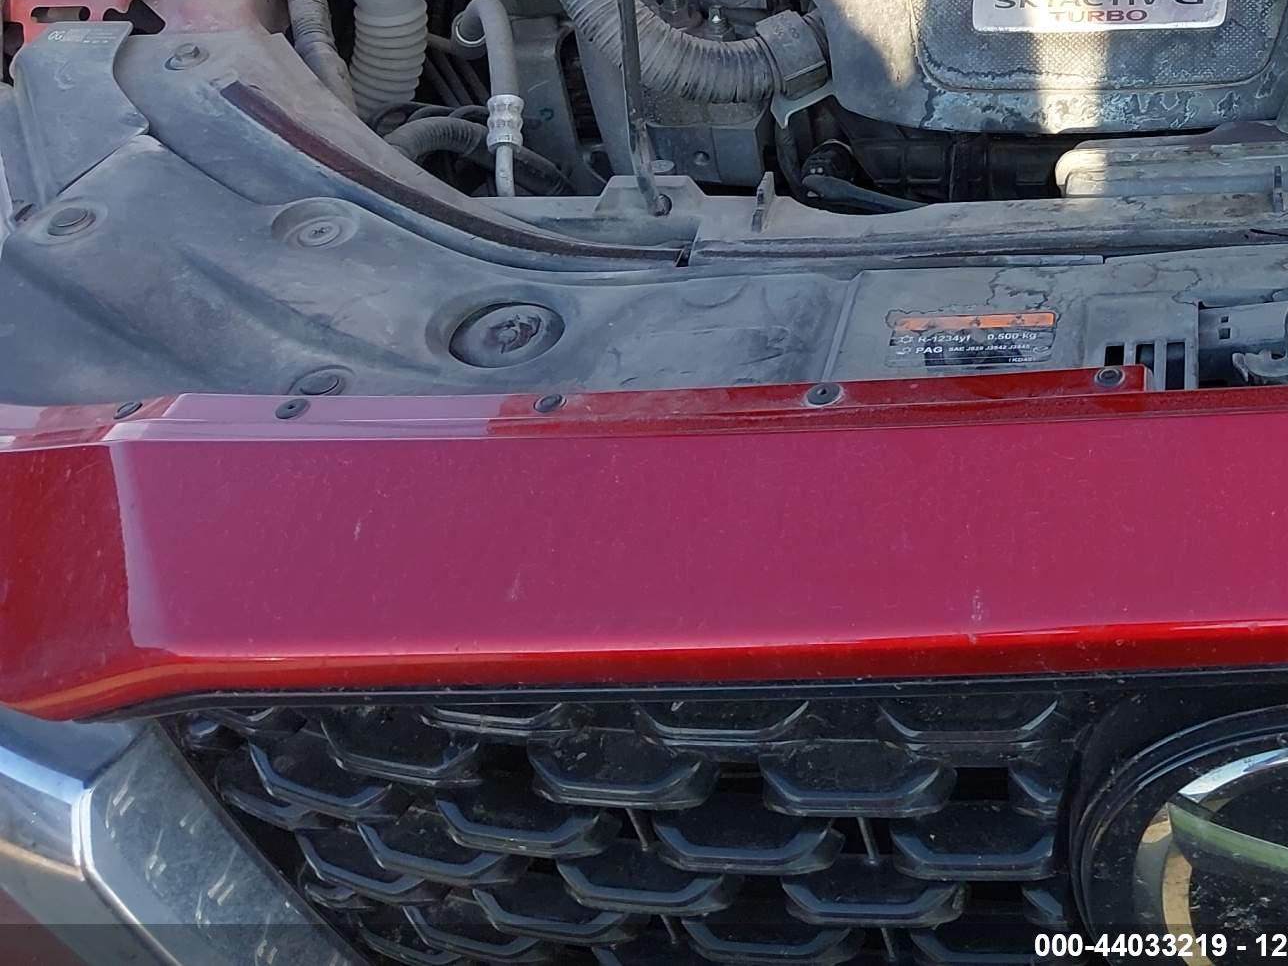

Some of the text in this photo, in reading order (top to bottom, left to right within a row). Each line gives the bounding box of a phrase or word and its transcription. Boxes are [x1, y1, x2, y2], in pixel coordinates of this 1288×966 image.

[1049, 10, 1148, 23] TURBO
[918, 334, 971, 343] R-1234yf
[915, 346, 943, 354] PAG
